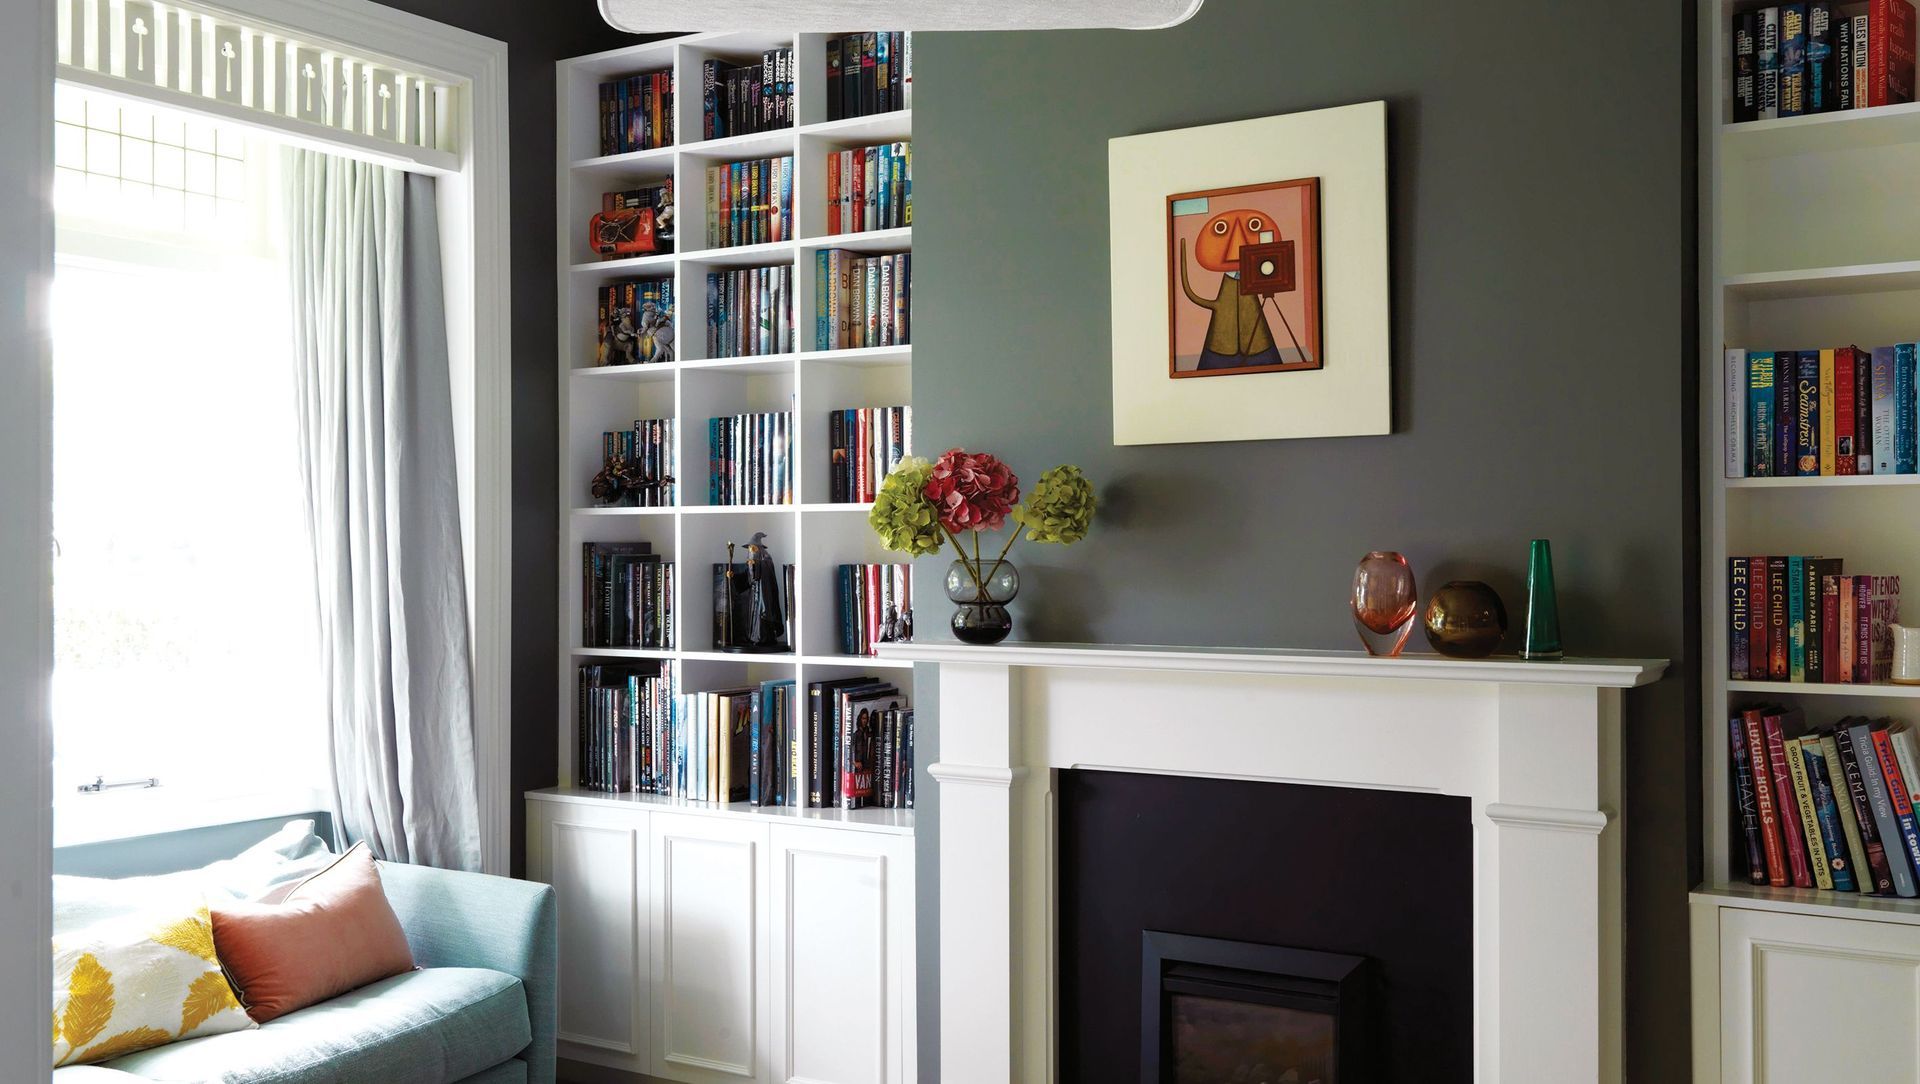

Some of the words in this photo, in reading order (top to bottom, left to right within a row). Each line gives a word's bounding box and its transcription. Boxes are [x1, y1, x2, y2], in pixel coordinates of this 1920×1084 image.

[1786, 10, 1794, 40] CUSSLER
[1794, 13, 1802, 35] CLIVE
[1812, 8, 1821, 37] CUSSLER
[1821, 11, 1829, 31] CLIVE
[1856, 18, 1866, 39] GILES
[1767, 24, 1776, 50] CLIVE
[1840, 23, 1849, 44] WHY
[1841, 46, 1849, 87] NATIONS
[1856, 42, 1866, 68] MILTON
[1757, 73, 1765, 112] ODYSSEY
[1766, 72, 1776, 107] TROJAN
[1792, 72, 1801, 112] TREASURE
[1841, 89, 1849, 109] FAIL
[1751, 358, 1763, 388] SMITH
[1762, 357, 1773, 388] WILBUR
[1781, 357, 1789, 384] JOANNE
[1874, 364, 1887, 400] SILVA
[1757, 401, 1766, 421] BIRDS
[1799, 379, 1816, 447] Seamstress
[1757, 423, 1766, 431] OF
[1757, 433, 1766, 450] PREY
[1734, 559, 1745, 584] LEE
[1753, 568, 1763, 590] LEE
[1773, 573, 1782, 592] LEE
[1792, 569, 1800, 593] STARTS
[1858, 584, 1866, 609] HOOVER
[1881, 576, 1900, 595] ENDS
[1734, 588, 1746, 631] CHILD
[1753, 593, 1763, 630] CHILD
[1773, 594, 1783, 626] CHILD
[1792, 596, 1800, 613] WITH
[1793, 615, 1800, 623] US
[1861, 656, 1868, 665] US
[883, 742, 891, 755] VAN
[1767, 730, 1787, 783] VILLA
[1858, 735, 1871, 756] Tricia
[884, 756, 892, 779] HALEN
[1790, 746, 1802, 770] GROW
[1838, 729, 1853, 755] KIT
[1846, 761, 1867, 803] KEMP
[1862, 756, 1878, 778] Guild:
[854, 773, 872, 790] VAN
[1748, 722, 1765, 771] LUXURY
[1757, 776, 1773, 825] HOTELS
[1795, 771, 1806, 792] FRUIT
[1824, 743, 1838, 771] PAUL
[1832, 773, 1850, 815] BANGAY
[1871, 778, 1880, 786] In
[1737, 764, 1758, 836] TRAVEL
[1871, 787, 1882, 799] my
[1880, 740, 1894, 775] Tricia
[1890, 779, 1907, 811] Guild
[1902, 818, 1912, 830] in
[1907, 834, 1920, 866] town
[1876, 800, 1888, 818] View
[1802, 801, 1818, 847] VEGETABLES
[1813, 847, 1819, 856] IN
[1816, 857, 1825, 876] POTS
